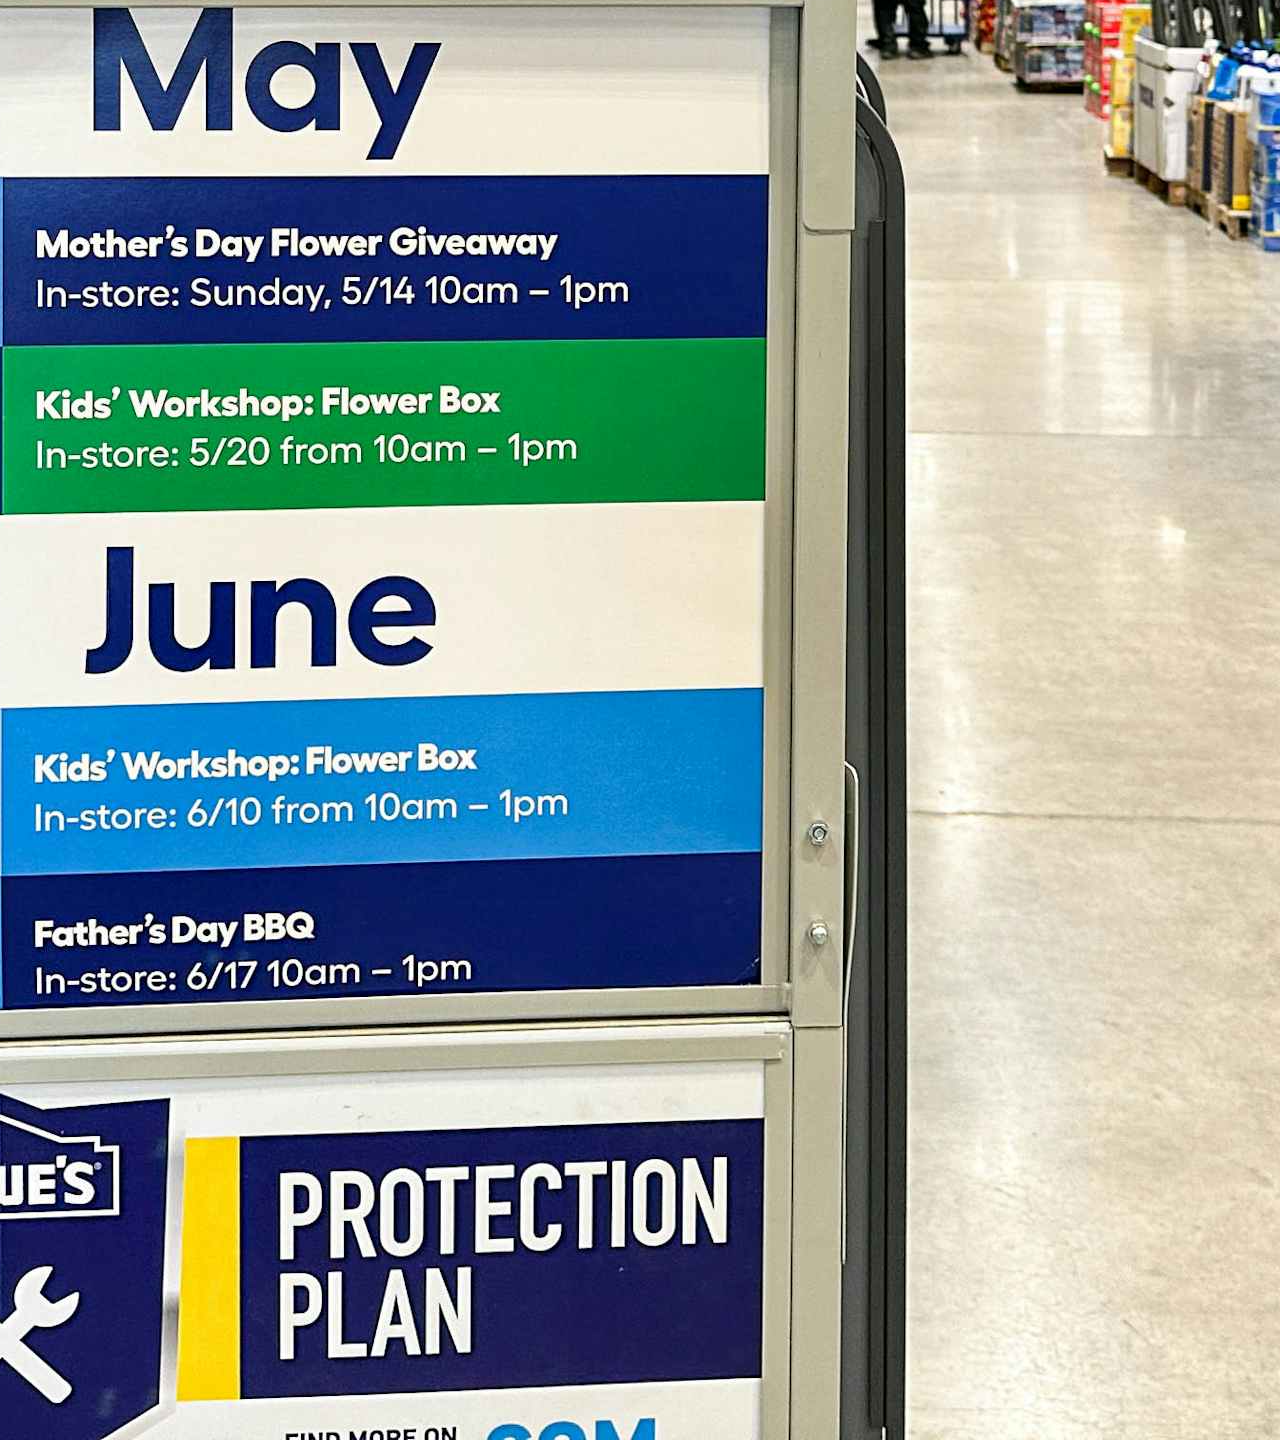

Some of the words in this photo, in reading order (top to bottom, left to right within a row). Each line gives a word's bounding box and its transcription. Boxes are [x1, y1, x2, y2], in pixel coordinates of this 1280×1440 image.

[92, 8, 442, 161] May
[36, 225, 189, 258] Mother's
[195, 228, 265, 263] Day
[270, 226, 384, 258] Flower
[389, 225, 559, 261] Giveaway
[36, 278, 180, 309] In-store:
[190, 277, 332, 312] Sunday,
[340, 275, 417, 306] 5/14
[424, 274, 519, 306] 10am
[559, 274, 629, 310] 1pm
[36, 386, 121, 420] Kids'
[127, 387, 314, 422] Workshop:
[321, 385, 434, 417] Flower
[438, 384, 502, 415] Box
[35, 439, 180, 470] In-store:
[188, 435, 271, 468] 5/20
[278, 434, 363, 466] from
[372, 432, 467, 464] 10am
[508, 432, 577, 467] 1pm
[84, 546, 437, 675] June
[34, 748, 116, 785] Kids'
[121, 748, 300, 782] Workshop:
[304, 744, 414, 776] Flower
[416, 741, 479, 773] Box
[34, 802, 178, 833] In-store:
[186, 795, 263, 829] 6/10
[270, 794, 355, 826] from
[363, 791, 459, 823] 10am
[499, 788, 568, 823] 1pm
[34, 912, 167, 948] Father's
[171, 915, 239, 948] Day
[242, 909, 316, 943] BBQ
[35, 965, 178, 996] In-store:
[185, 959, 259, 992] 6/17
[266, 957, 361, 989] 10am
[402, 954, 471, 990] 1pm
[279, 1156, 728, 1260] PROTECTION
[279, 1266, 472, 1360] PLAN
